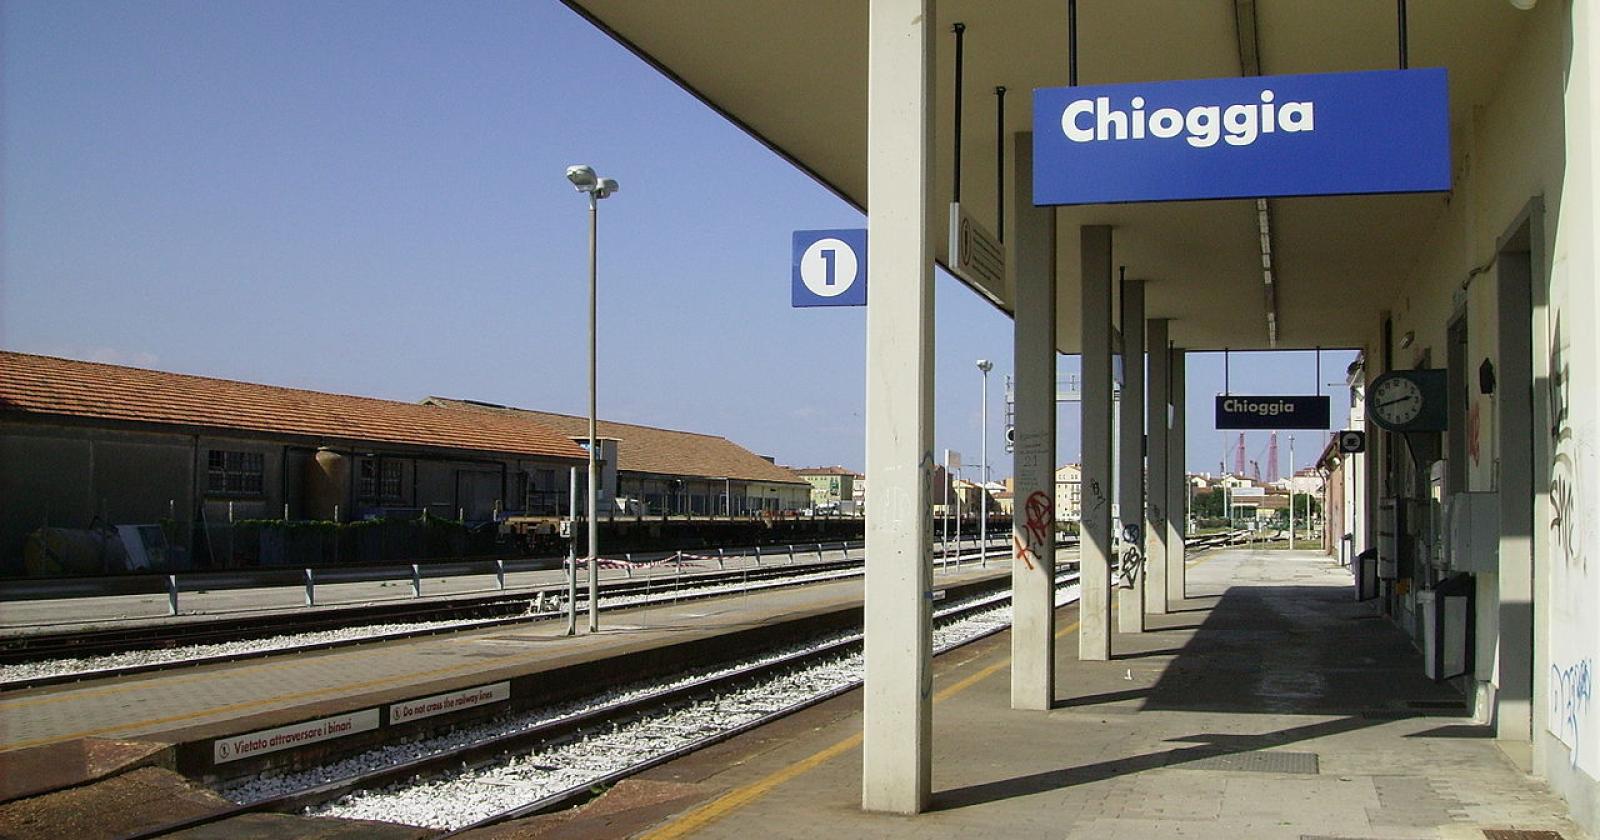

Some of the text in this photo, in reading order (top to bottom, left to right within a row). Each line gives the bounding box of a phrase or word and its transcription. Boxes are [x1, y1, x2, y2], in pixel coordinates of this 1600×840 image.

[1061, 89, 1314, 148] Chioggia
[821, 249, 836, 286] 1
[1223, 399, 1295, 416] Chioggia
[403, 689, 493, 717] Do not cross the railway lines
[233, 738, 268, 755] Vietato
[269, 727, 322, 747] attraversare
[328, 718, 352, 734] binari
